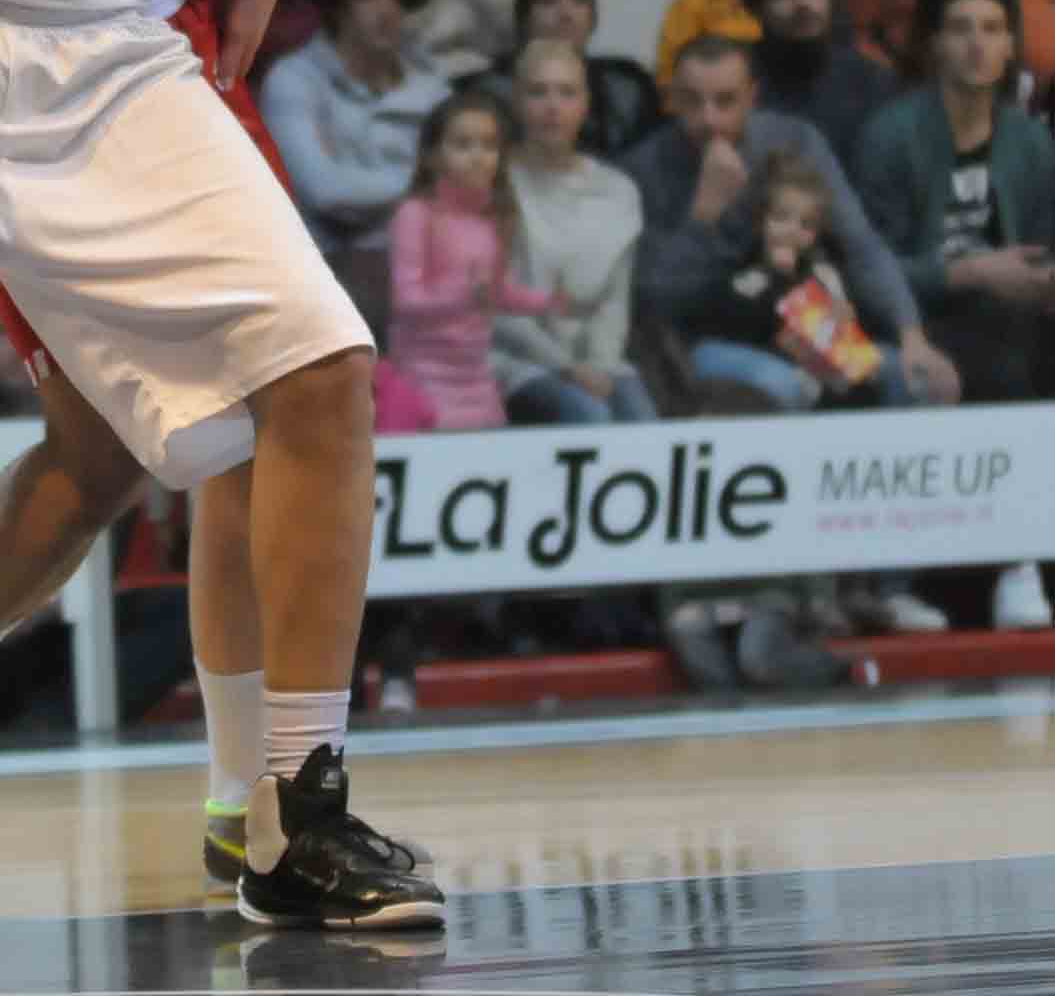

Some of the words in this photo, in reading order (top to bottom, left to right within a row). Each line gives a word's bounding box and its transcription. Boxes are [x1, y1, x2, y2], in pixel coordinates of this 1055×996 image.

[375, 458, 509, 558] La
[527, 442, 788, 568] Jolie
[819, 455, 941, 500] MAKE
[952, 450, 1012, 497] UP
